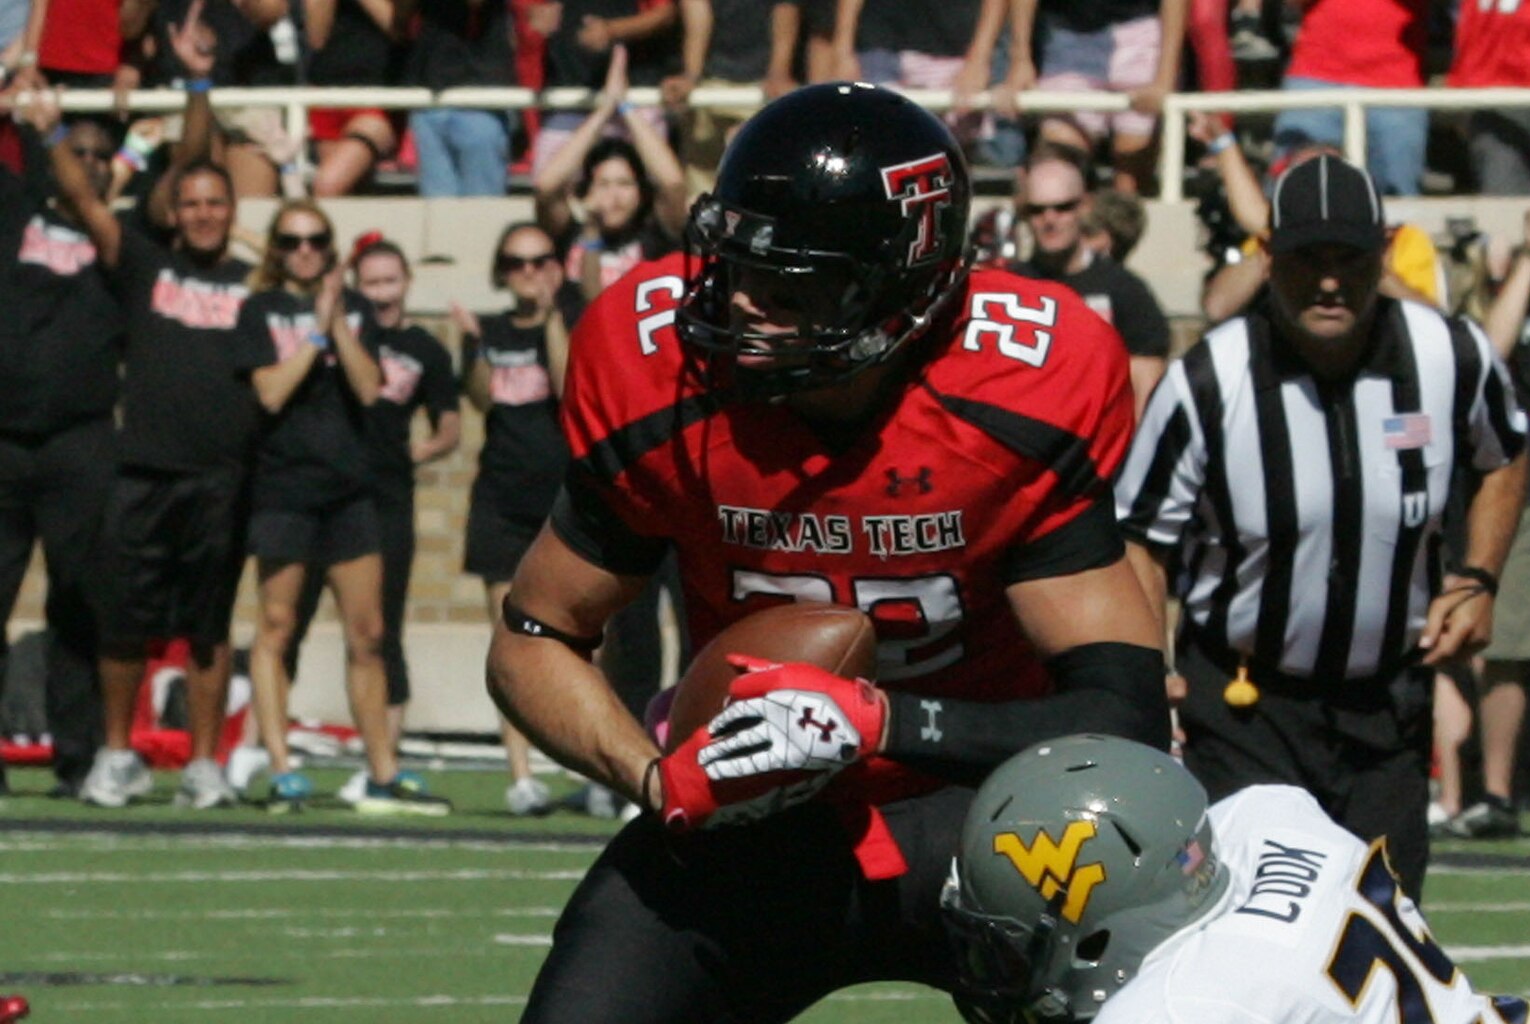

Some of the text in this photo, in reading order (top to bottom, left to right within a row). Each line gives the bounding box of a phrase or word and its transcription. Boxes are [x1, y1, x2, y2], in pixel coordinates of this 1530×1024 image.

[963, 291, 1058, 369] 22
[718, 504, 966, 558] TEXAS TECH
[1403, 491, 1427, 528] U
[1234, 838, 1328, 923] COOK
